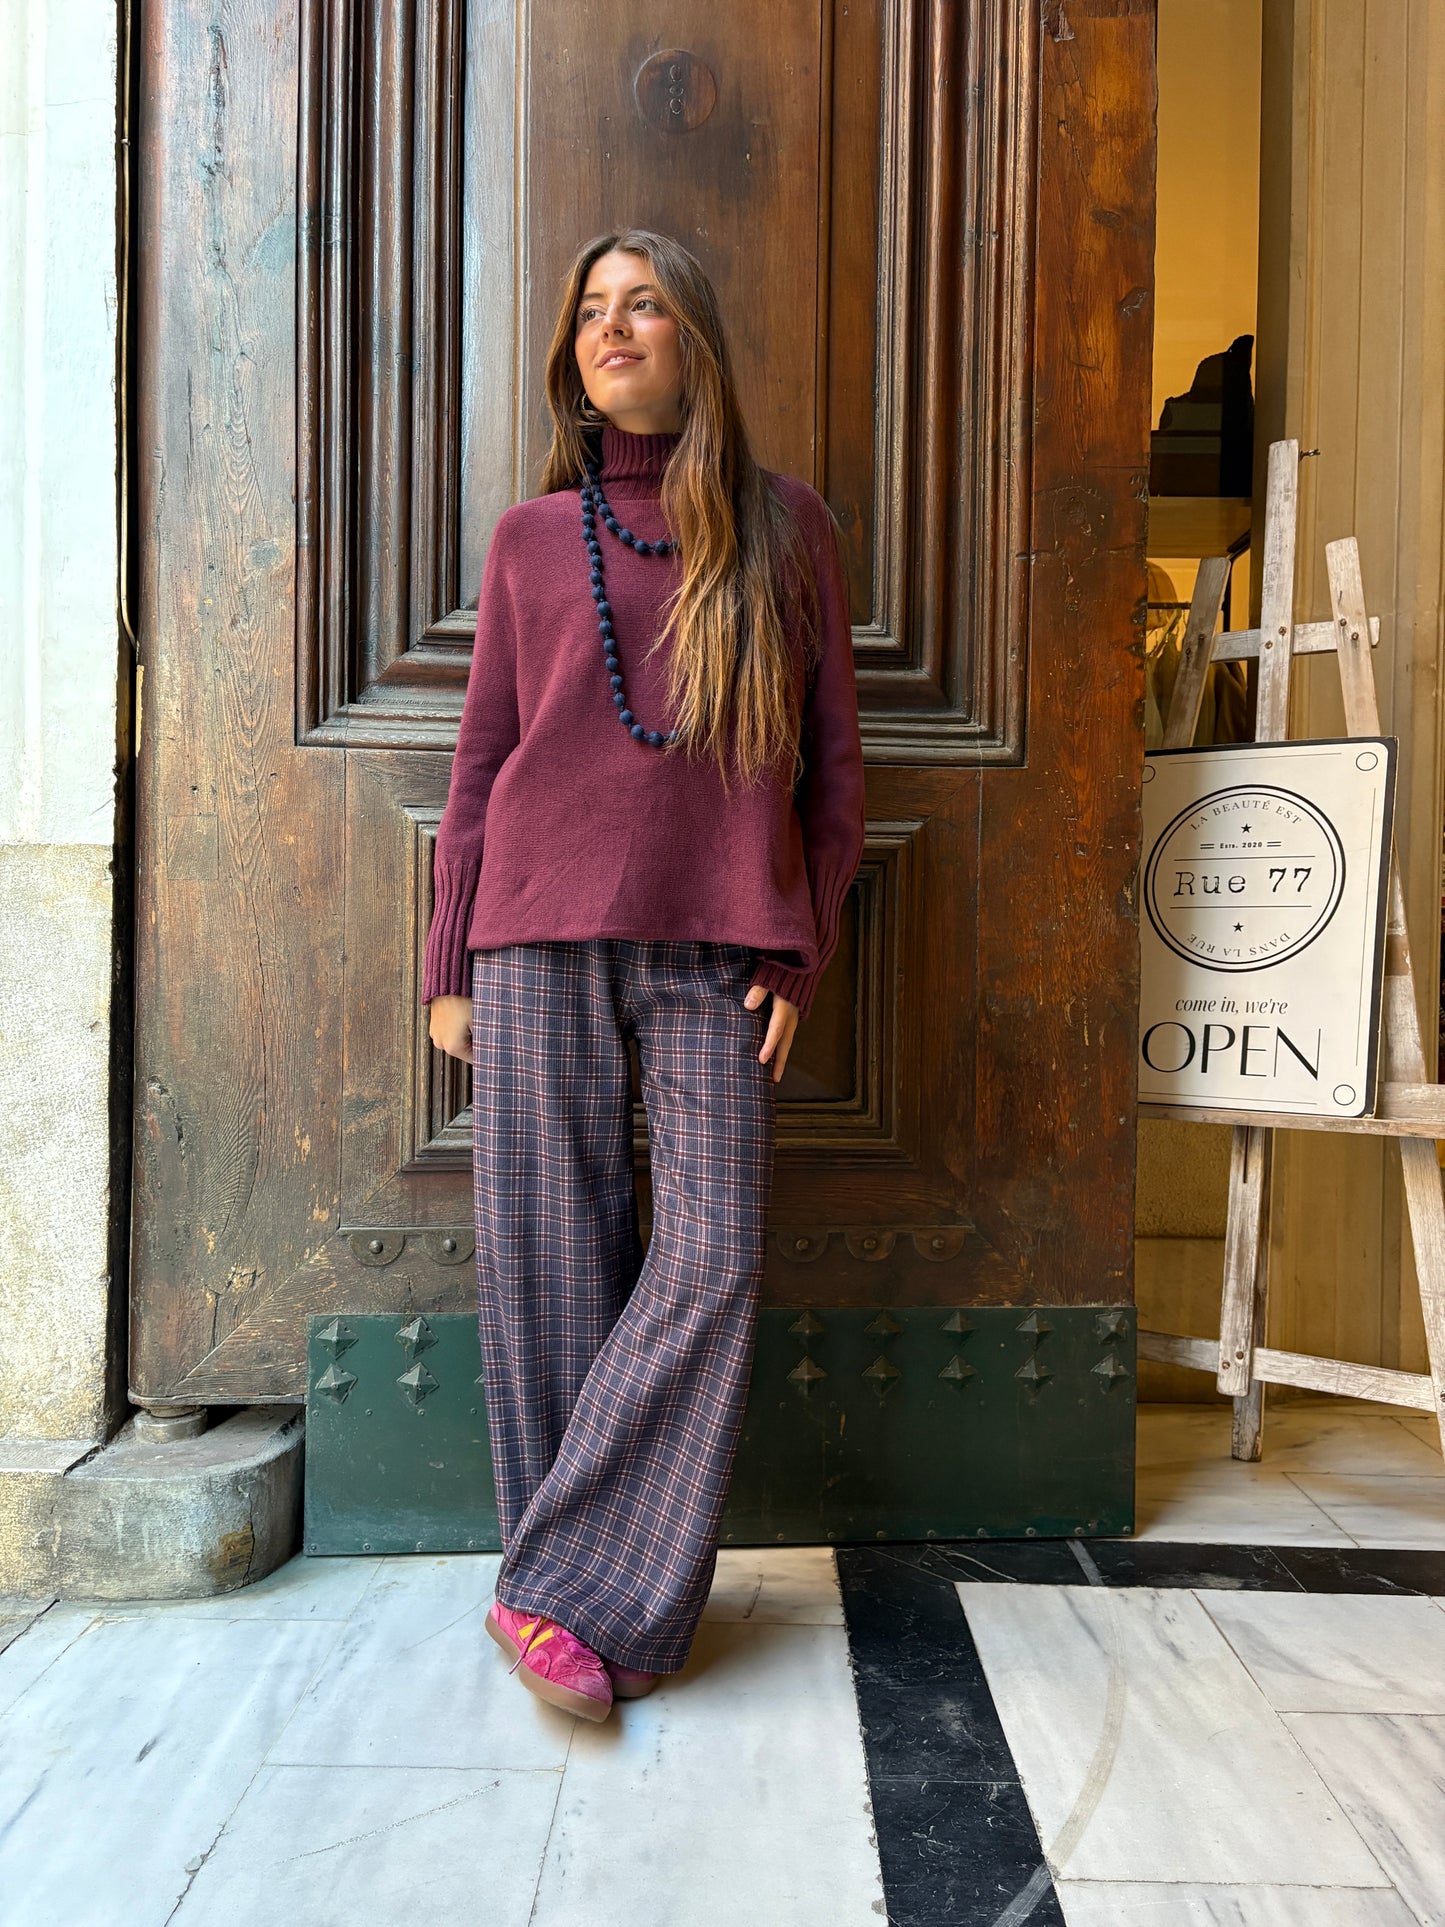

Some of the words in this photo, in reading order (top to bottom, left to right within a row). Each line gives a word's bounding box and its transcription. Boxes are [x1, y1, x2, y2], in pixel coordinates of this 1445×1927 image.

[1190, 816, 1208, 831] LA
[1212, 800, 1271, 816] BEAUTÉ
[1275, 806, 1302, 825] EST
[1242, 841, 1263, 849] 2020
[1173, 871, 1246, 897] Rue
[1268, 867, 1312, 893] 77
[1187, 933, 1216, 954] RUE
[1223, 948, 1241, 957] LA
[1249, 933, 1291, 956] DANS
[1175, 998, 1216, 1012] come
[1220, 996, 1239, 1015] in,
[1245, 998, 1289, 1014] we're
[1141, 1021, 1322, 1081] OPEN
